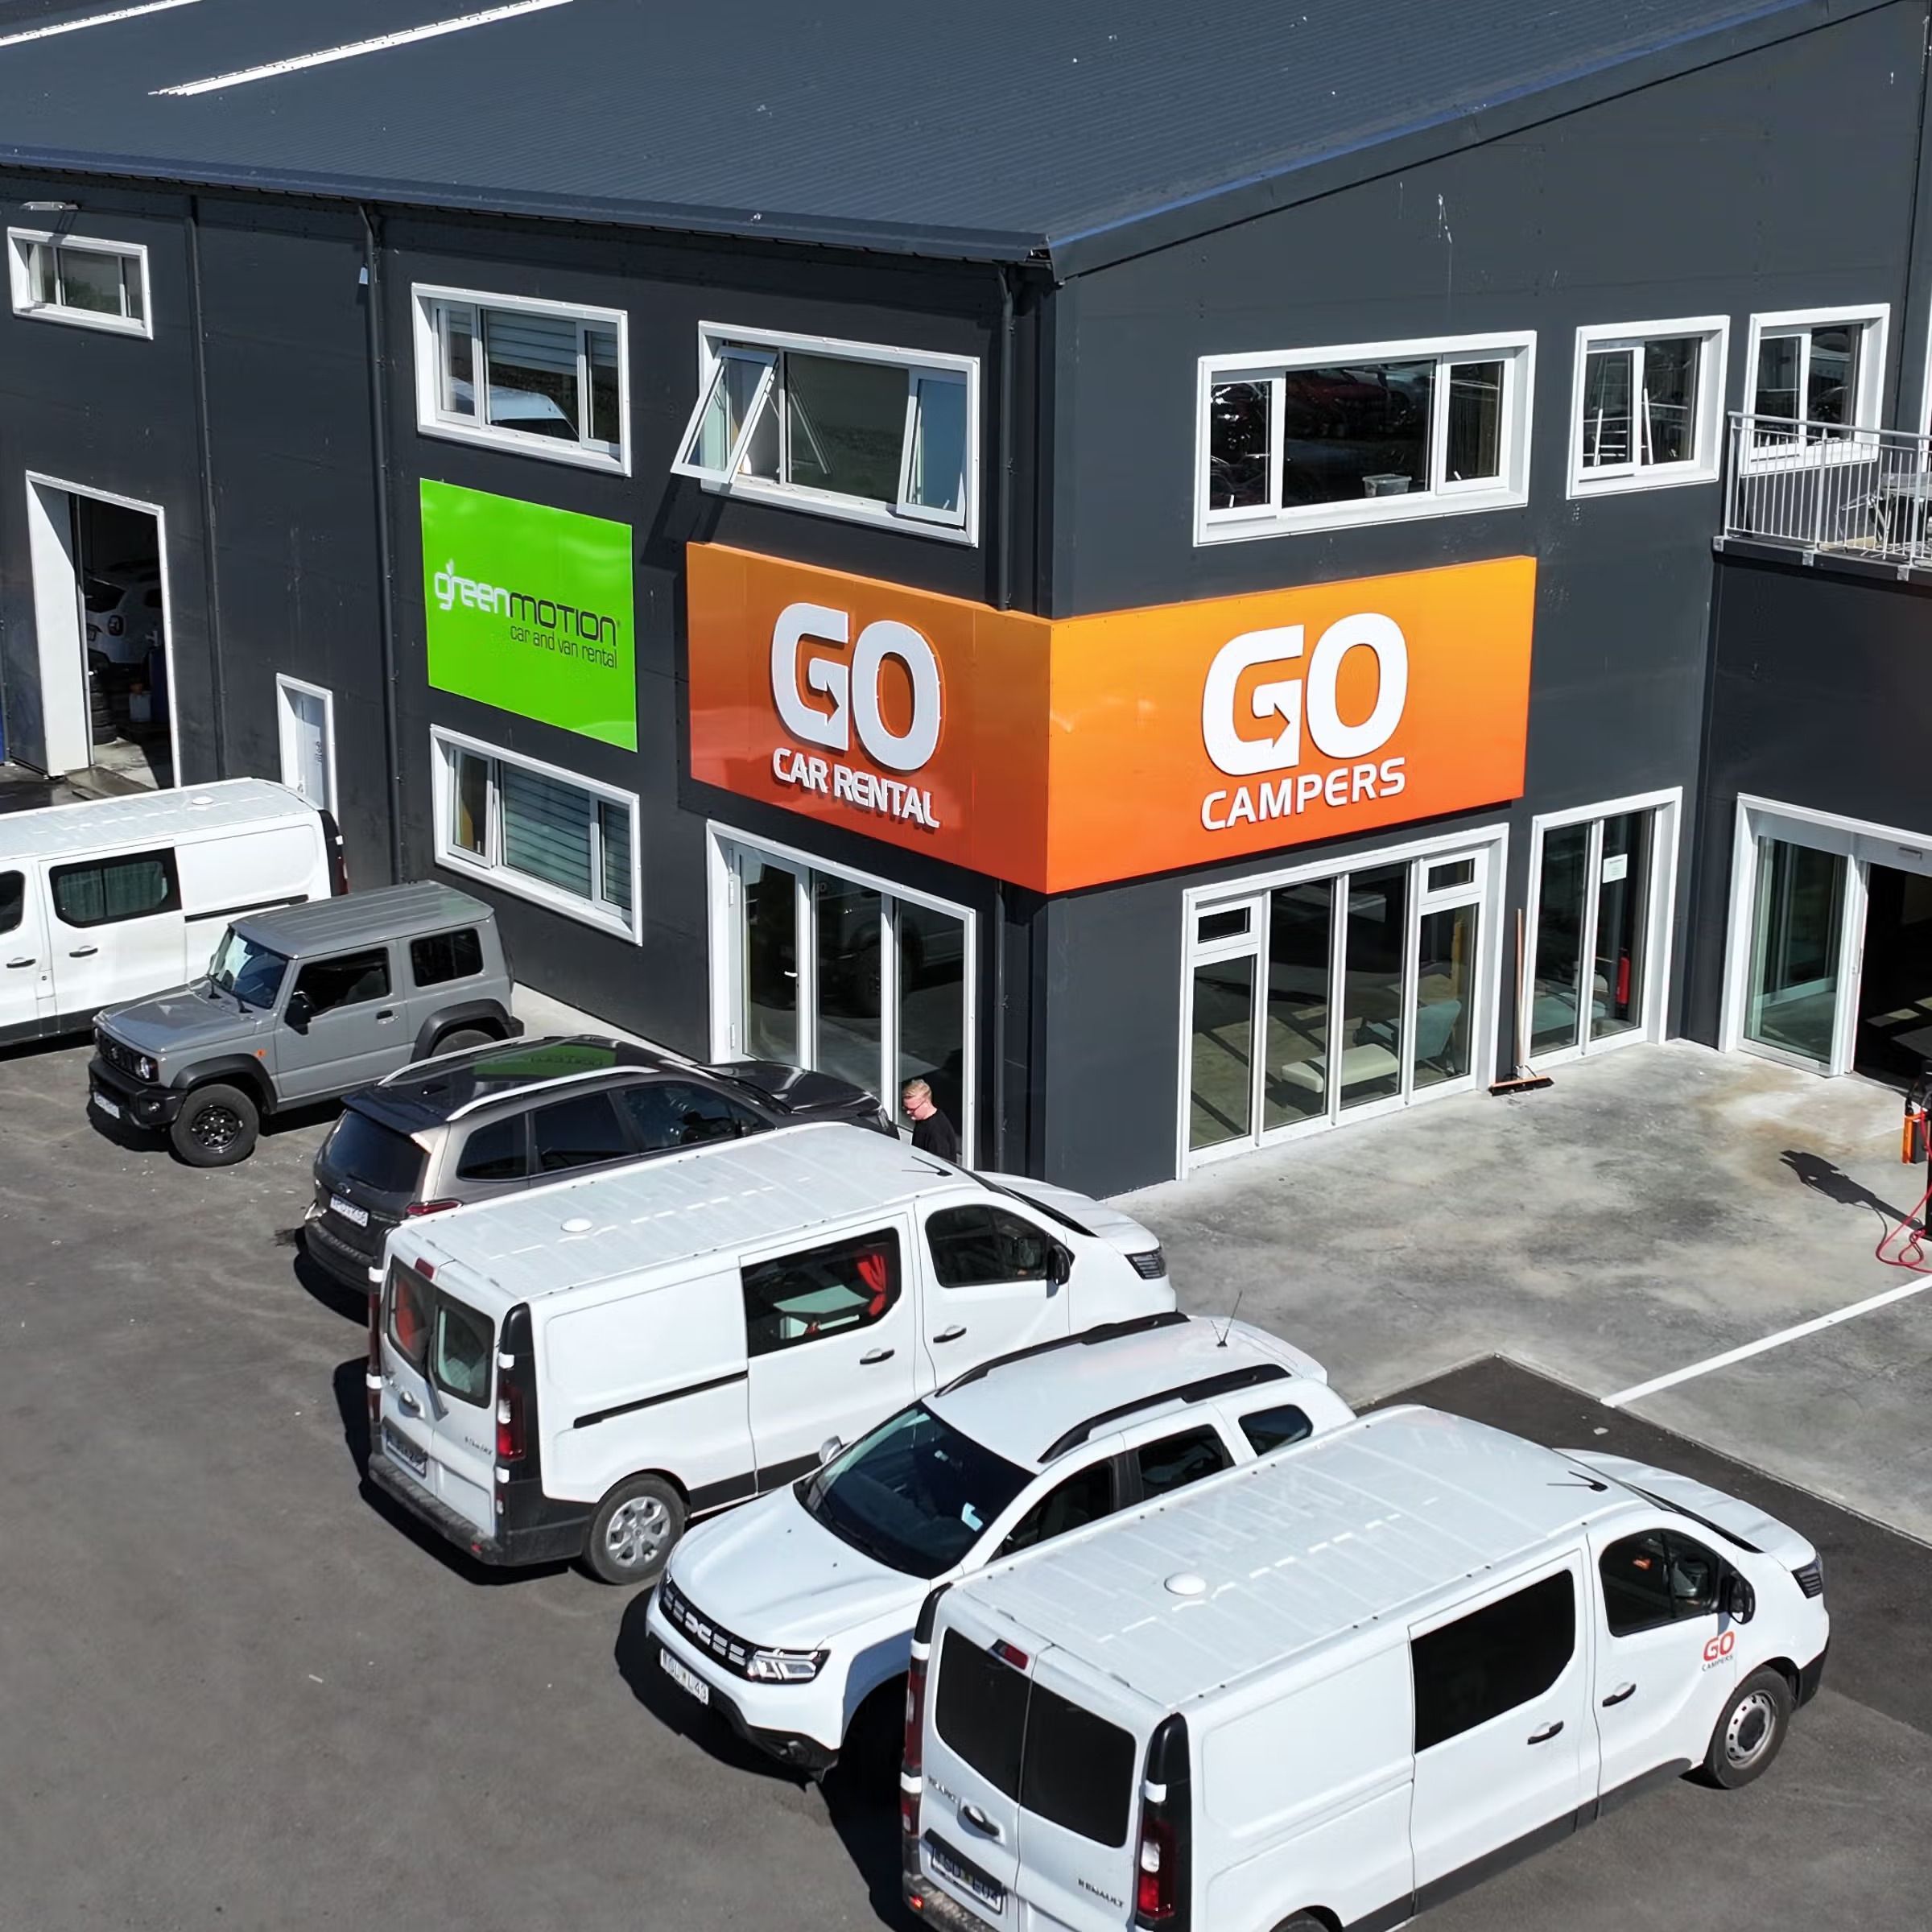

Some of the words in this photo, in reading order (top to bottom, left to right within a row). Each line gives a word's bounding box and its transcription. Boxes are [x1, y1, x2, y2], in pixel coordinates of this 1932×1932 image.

[510, 625, 530, 643] car
[533, 630, 555, 650] and
[558, 638, 578, 658] van
[582, 645, 617, 669] rental
[772, 602, 940, 771] GO
[1201, 612, 1409, 776] GO
[773, 747, 828, 793] CAR
[834, 764, 940, 828] RENTAL
[1201, 757, 1406, 831] CAMPERS
[1703, 1631, 1735, 1662] GO
